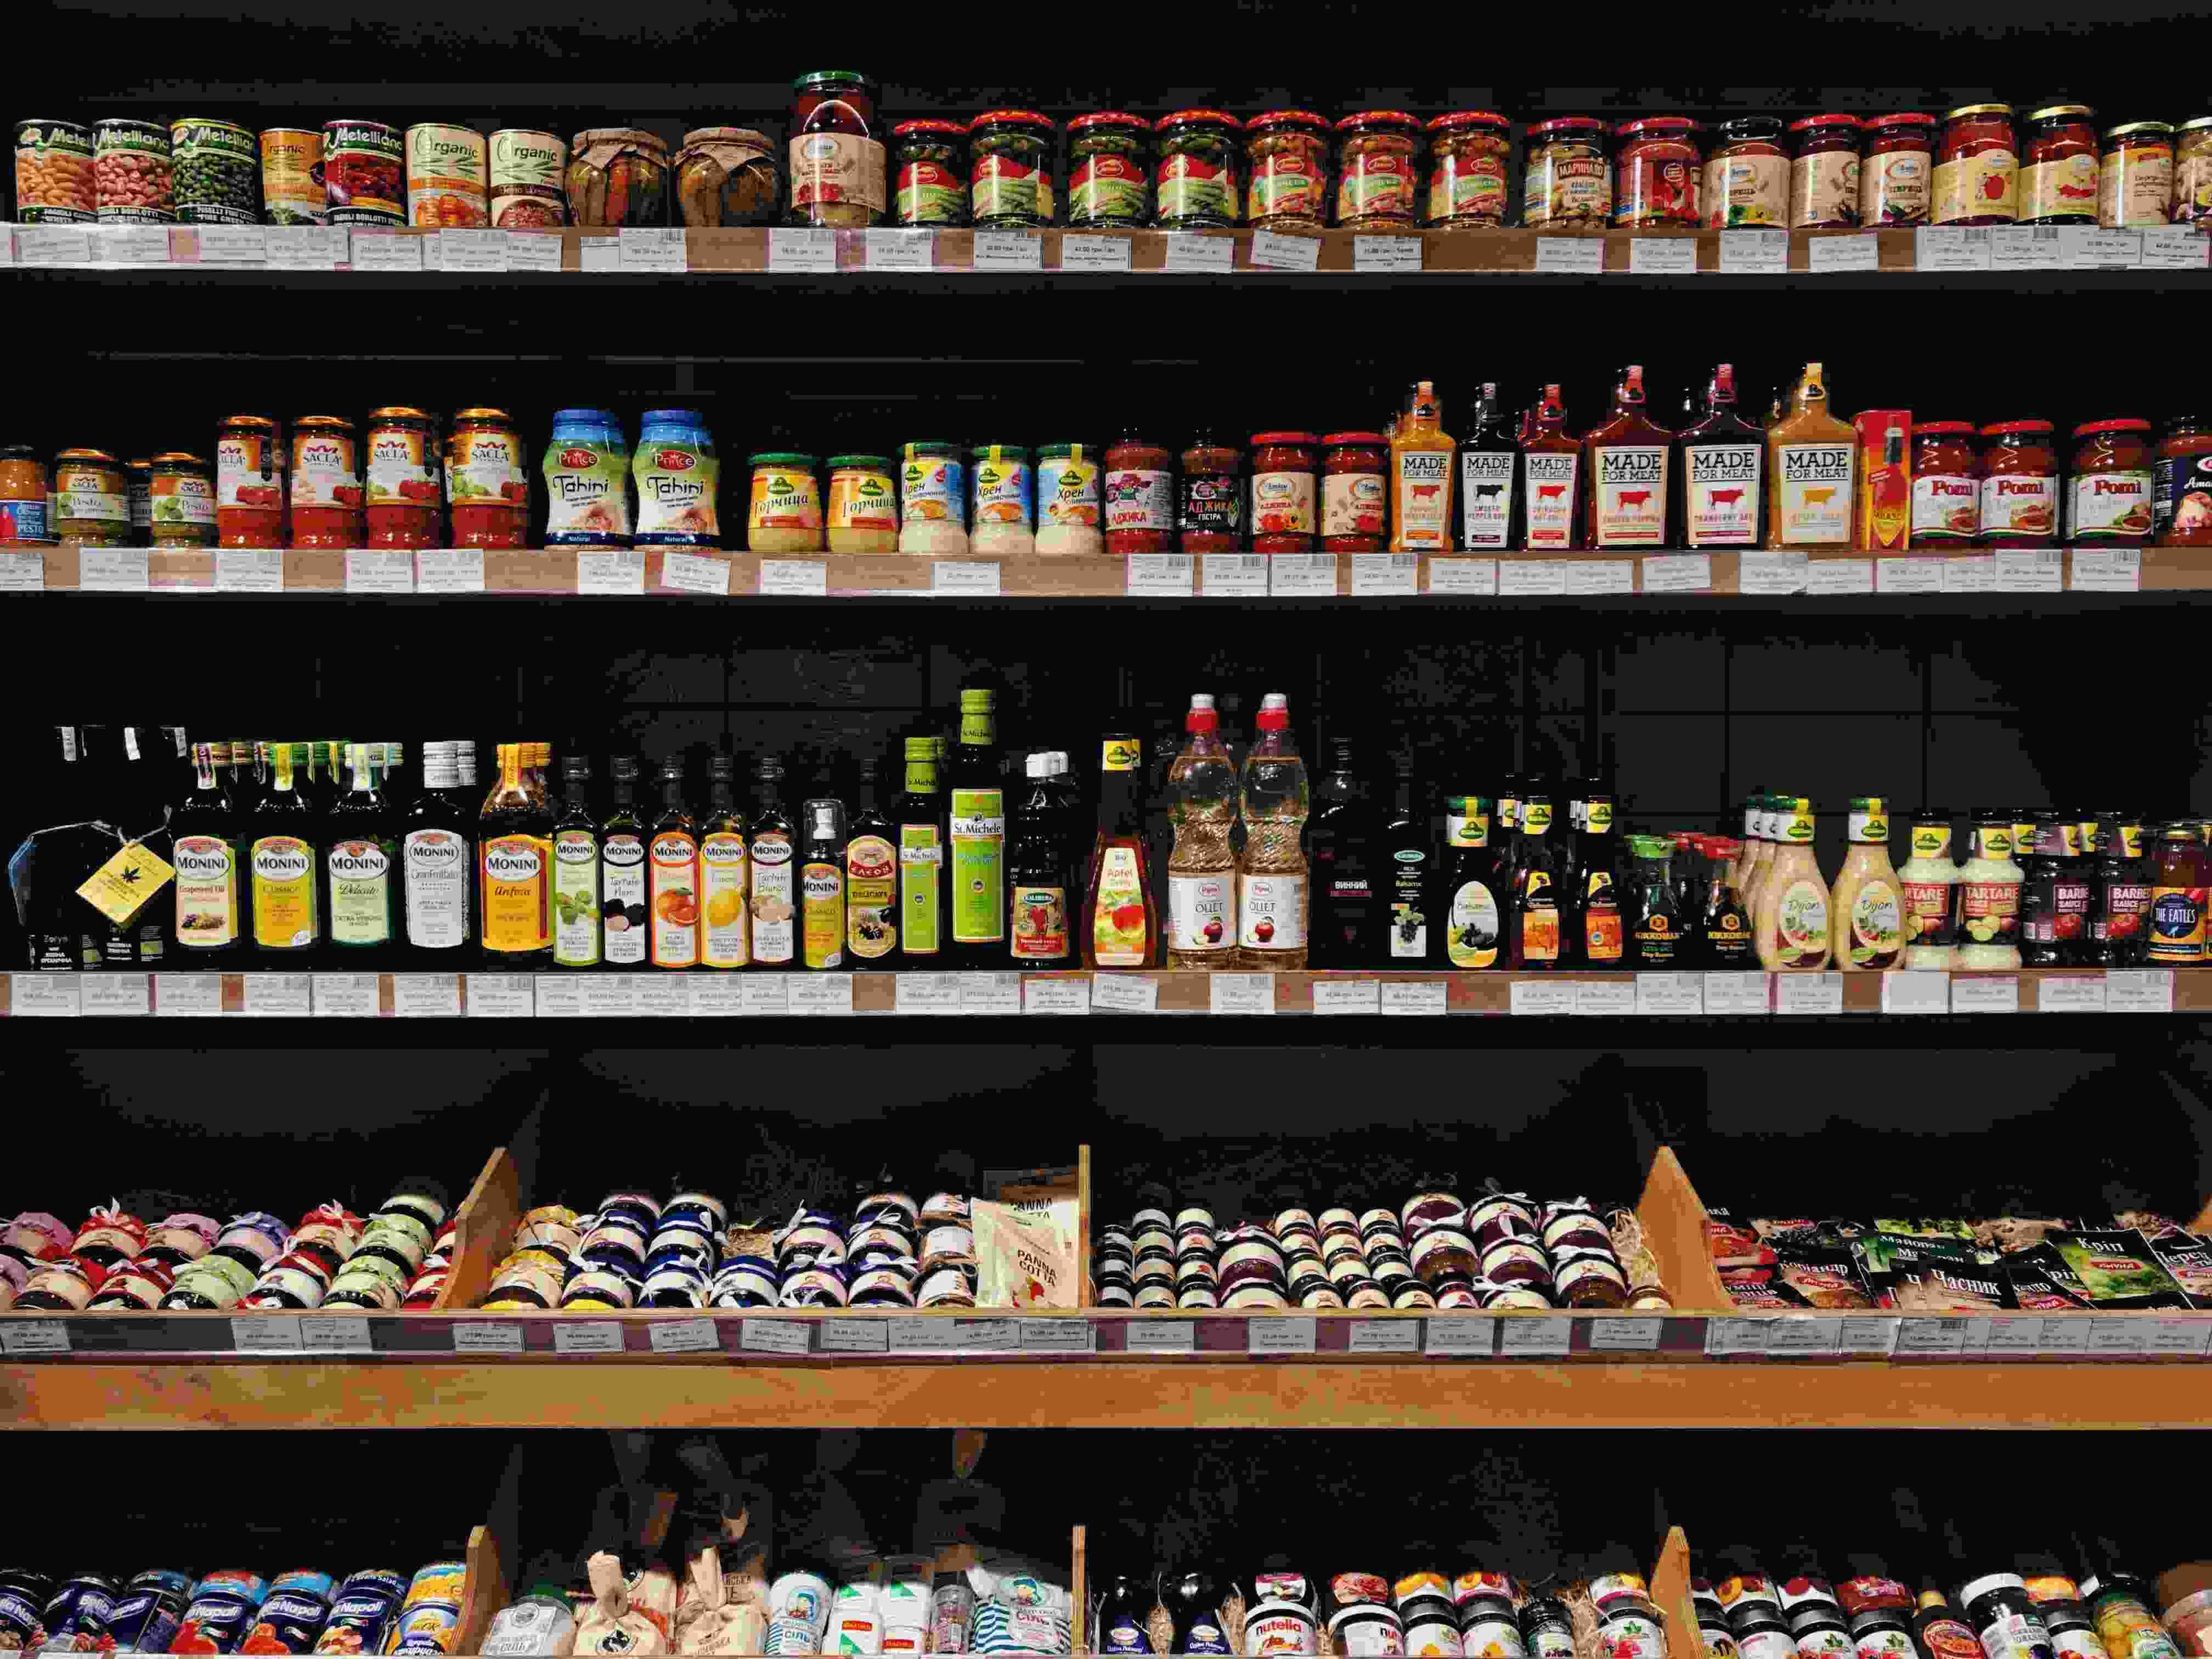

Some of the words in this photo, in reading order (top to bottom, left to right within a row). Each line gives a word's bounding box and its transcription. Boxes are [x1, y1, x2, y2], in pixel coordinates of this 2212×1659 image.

[1404, 457, 1447, 470] MADE
[1467, 457, 1510, 470] MADE
[1529, 459, 1571, 470] MADE
[1601, 454, 1662, 470] MADE
[1692, 452, 1755, 469] MADE
[1786, 451, 1848, 469] MADE
[1601, 470, 1628, 481] FOR
[1630, 470, 1661, 481] MEAT
[1692, 470, 1718, 479] FOR
[1719, 468, 1756, 479] MEAT
[1786, 468, 1811, 479] FOR
[1813, 467, 1848, 479] MEAT
[552, 475, 610, 499] Tahini
[646, 475, 705, 500] Tahini
[1188, 500, 1234, 513] АДЖИКА
[413, 847, 455, 858] MONINI
[557, 844, 594, 855] MONINI
[606, 846, 641, 855] MONINI
[654, 847, 693, 857] MONINI
[706, 846, 742, 857] MONINI
[754, 846, 790, 855] MONINI
[177, 857, 226, 870] MONINI
[257, 856, 306, 869] MONINI
[331, 857, 384, 870] MONINI
[487, 858, 538, 871] MONINI
[801, 881, 839, 892] MONINI
[1787, 899, 1820, 912] Dijon
[1860, 899, 1893, 914] Dijon
[2076, 1237, 2125, 1252] Кріп
[1018, 1249, 1057, 1279] PANNA
[1019, 1259, 1057, 1288] COTTA
[341, 1600, 384, 1613] Napoli
[1256, 1618, 1303, 1636] nutella
